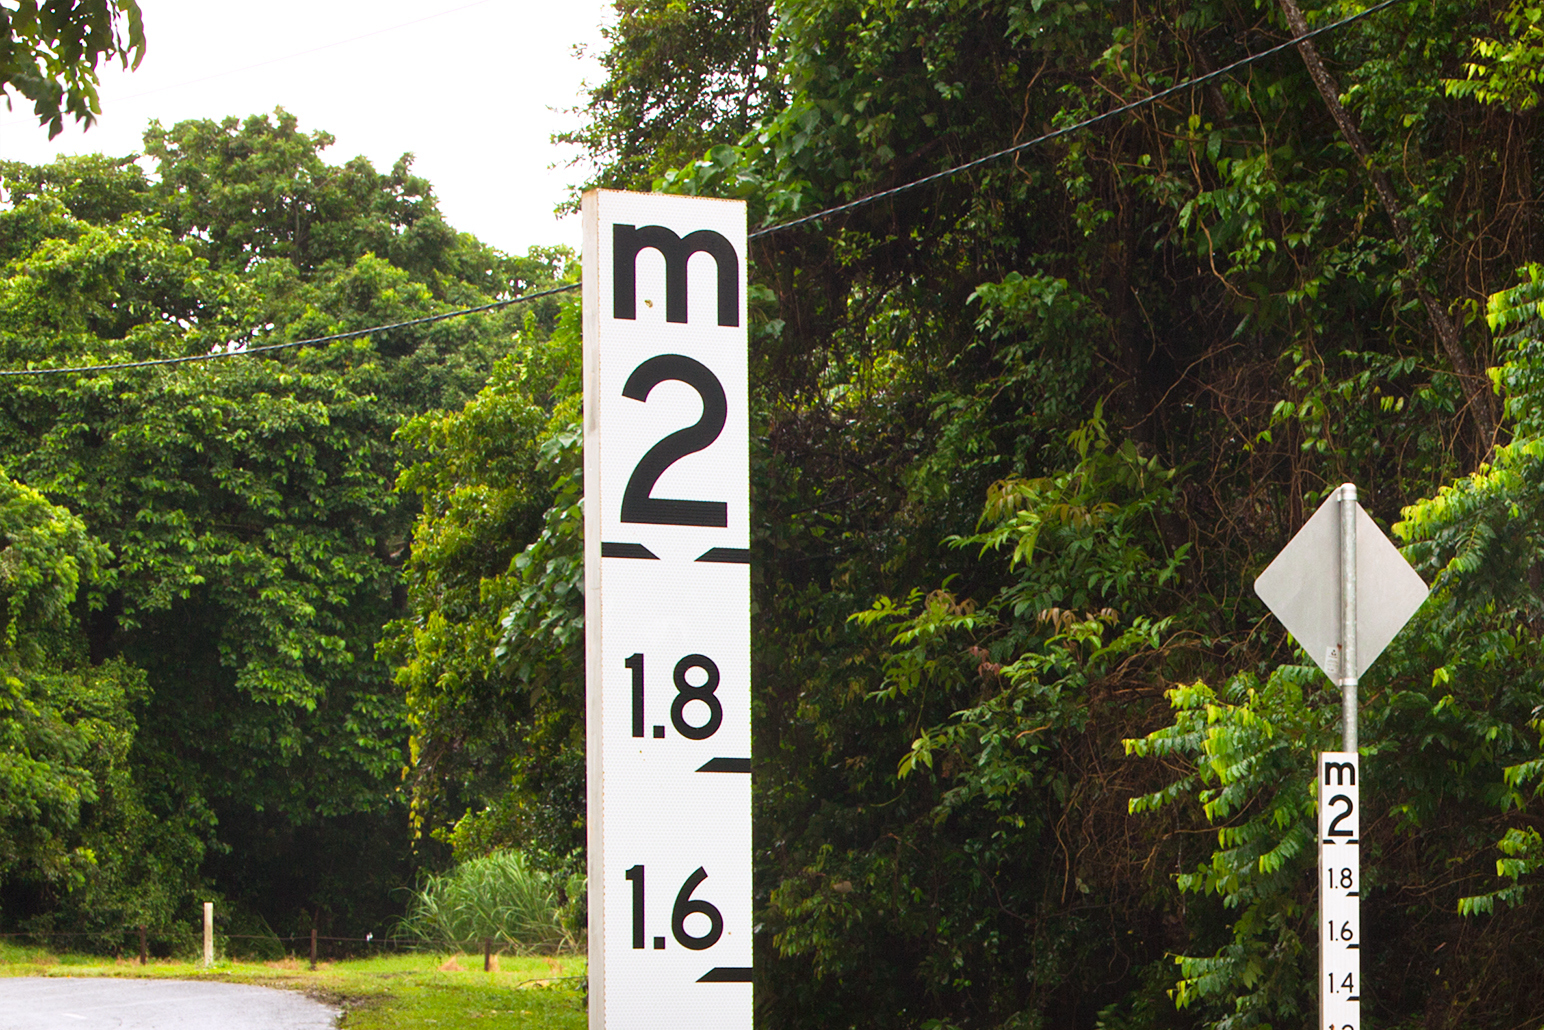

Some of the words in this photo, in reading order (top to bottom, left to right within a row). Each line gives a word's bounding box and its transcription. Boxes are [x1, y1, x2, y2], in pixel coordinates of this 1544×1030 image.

[613, 223, 740, 328] m
[620, 353, 728, 528] 2
[624, 652, 723, 741] 1.8
[1325, 762, 1355, 786] m
[1328, 794, 1354, 837] 2
[1328, 867, 1353, 889] 1.8
[625, 864, 724, 951] 1.6
[1328, 920, 1353, 941] 1.6
[1328, 972, 1354, 994] 1.4
